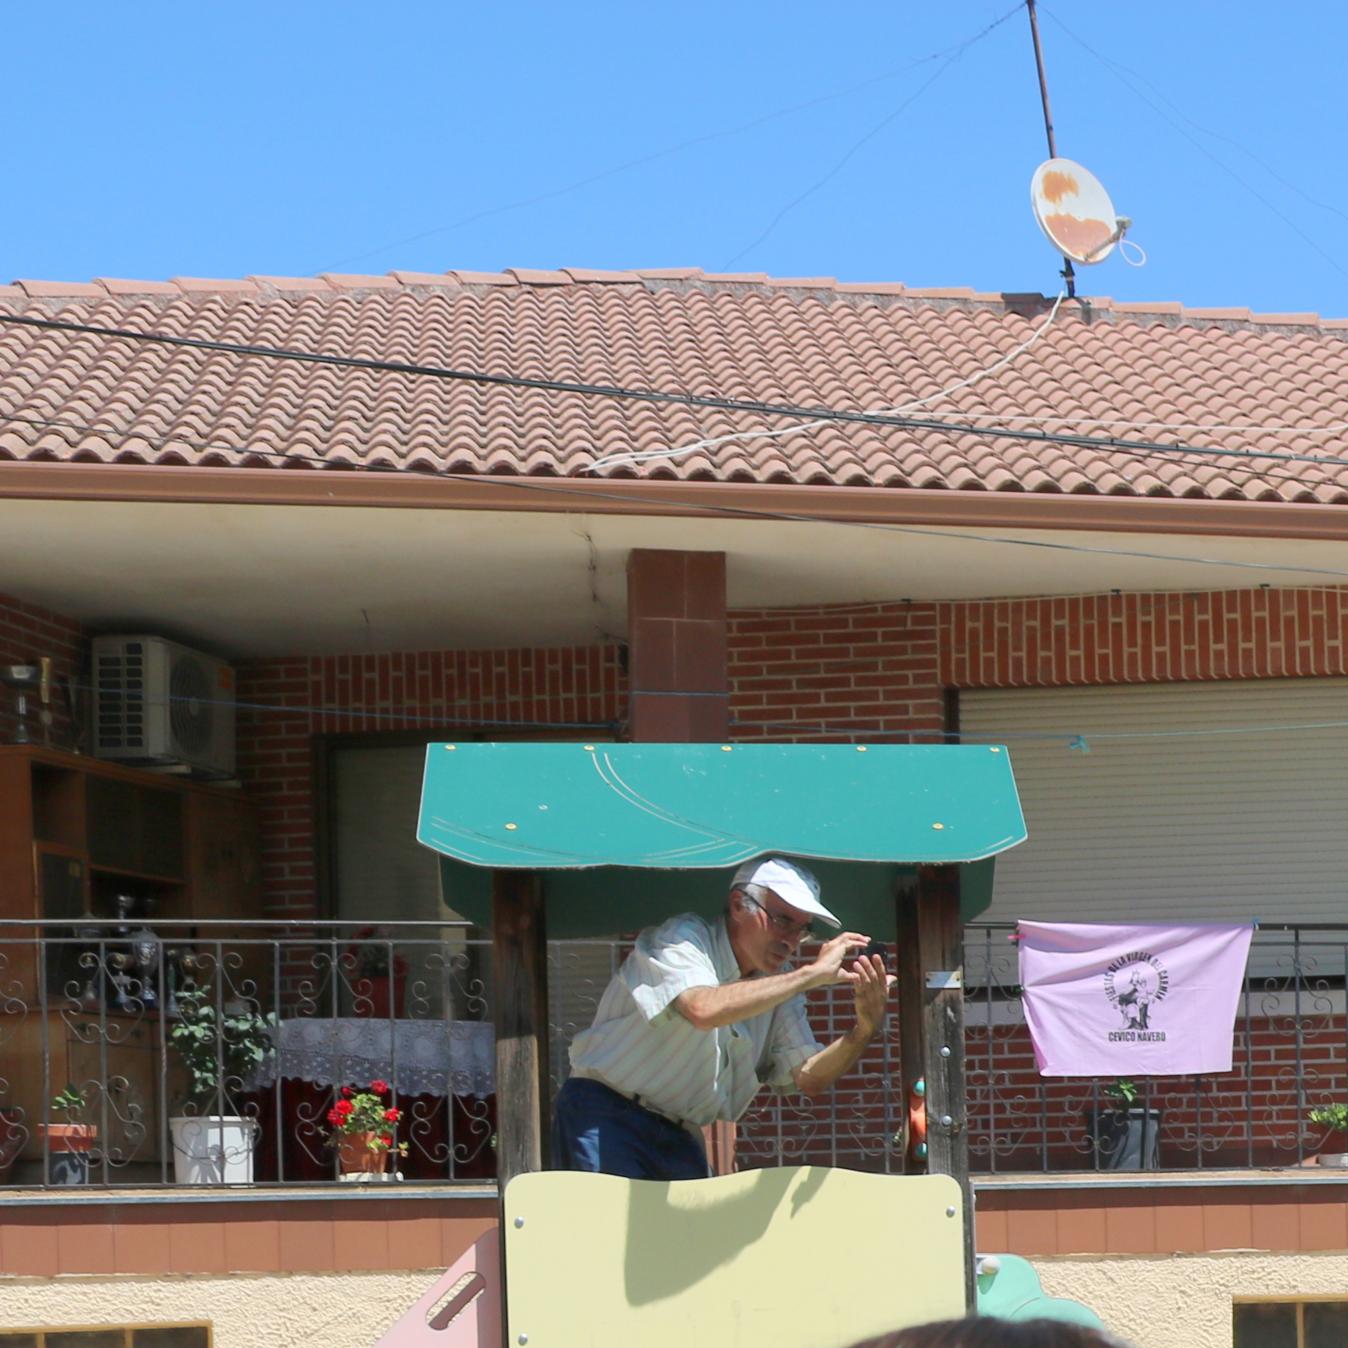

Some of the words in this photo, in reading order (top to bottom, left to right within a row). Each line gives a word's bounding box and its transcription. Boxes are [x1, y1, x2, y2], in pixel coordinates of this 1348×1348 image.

[1116, 956, 1128, 967] LA
[1126, 951, 1153, 962] VIRGEN
[1154, 969, 1169, 1002] CARMEN
[1108, 1031, 1136, 1042] CEVICO
[1137, 1031, 1166, 1042] NAVERO
